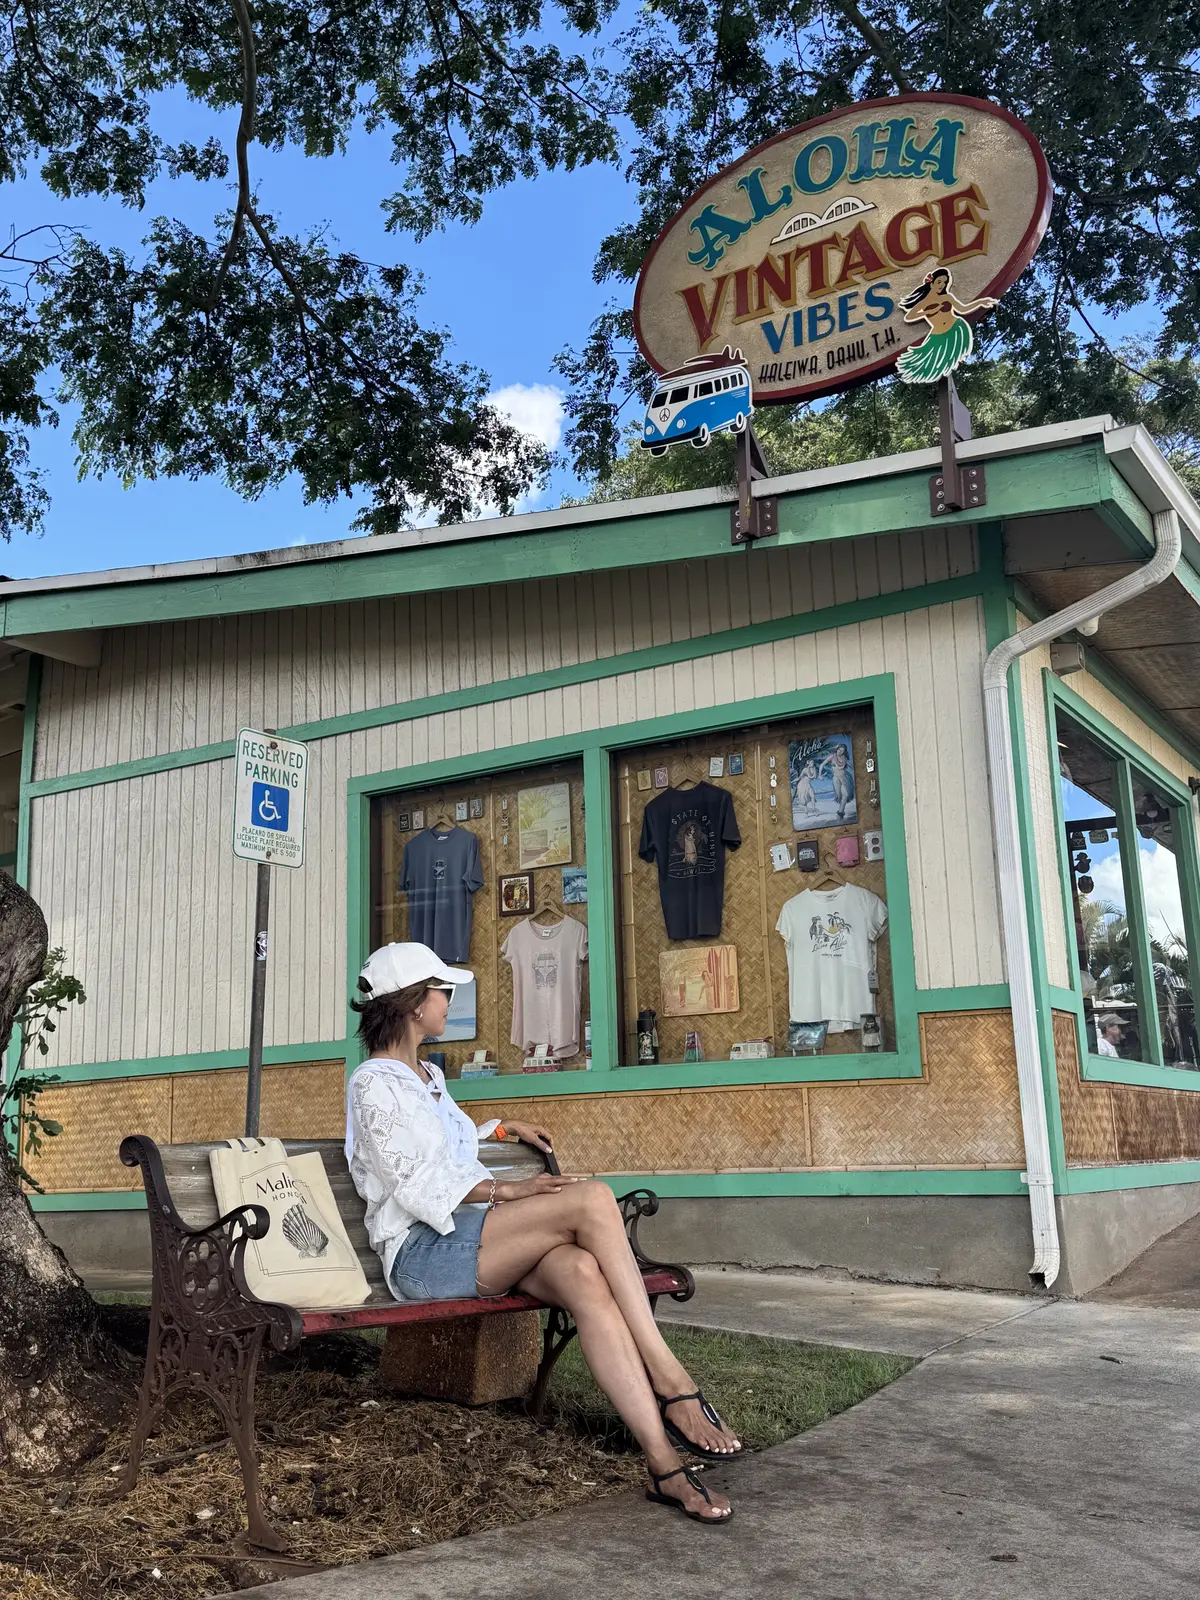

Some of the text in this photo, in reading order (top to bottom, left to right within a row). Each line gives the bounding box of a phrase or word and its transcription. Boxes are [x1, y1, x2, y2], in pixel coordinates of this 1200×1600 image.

[687, 117, 965, 271] ALOHA
[676, 183, 991, 353] VINTAGE
[760, 281, 895, 354] VIBES
[872, 326, 901, 352] T.H.
[242, 740, 303, 769] RESERVED
[793, 739, 827, 765] Aloha
[245, 761, 299, 788] PARKING
[672, 809, 698, 825] STATE
[236, 833, 301, 852] LICENSE PLATE REQUIRED
[241, 841, 266, 852] MAXIMUM
[242, 826, 296, 844] PLACARD OR SPECIAL
